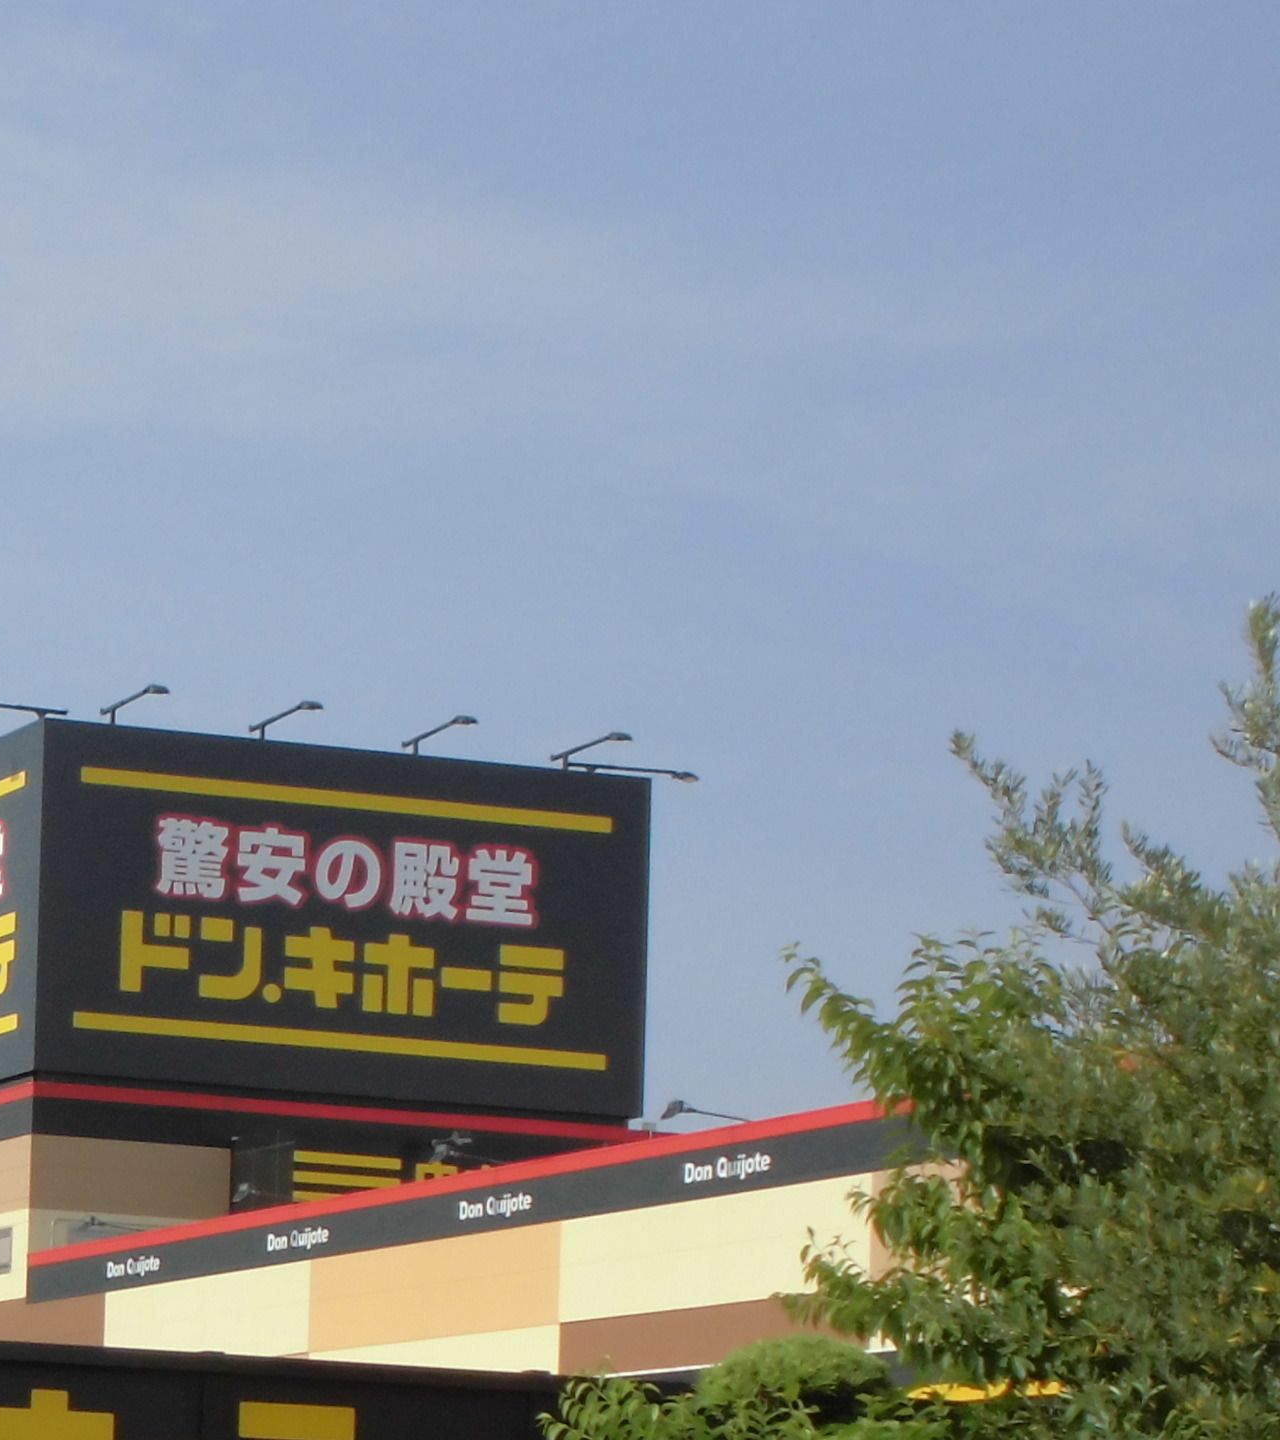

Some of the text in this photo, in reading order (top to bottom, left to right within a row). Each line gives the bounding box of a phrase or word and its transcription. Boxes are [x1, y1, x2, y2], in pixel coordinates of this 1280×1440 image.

[156, 816, 534, 926] 驚安の殿堂
[683, 1152, 771, 1184] Don Quijote
[458, 1191, 532, 1221] Don Quijote
[266, 1225, 330, 1252] Don Quijote
[105, 1255, 161, 1279] Don Quijote
